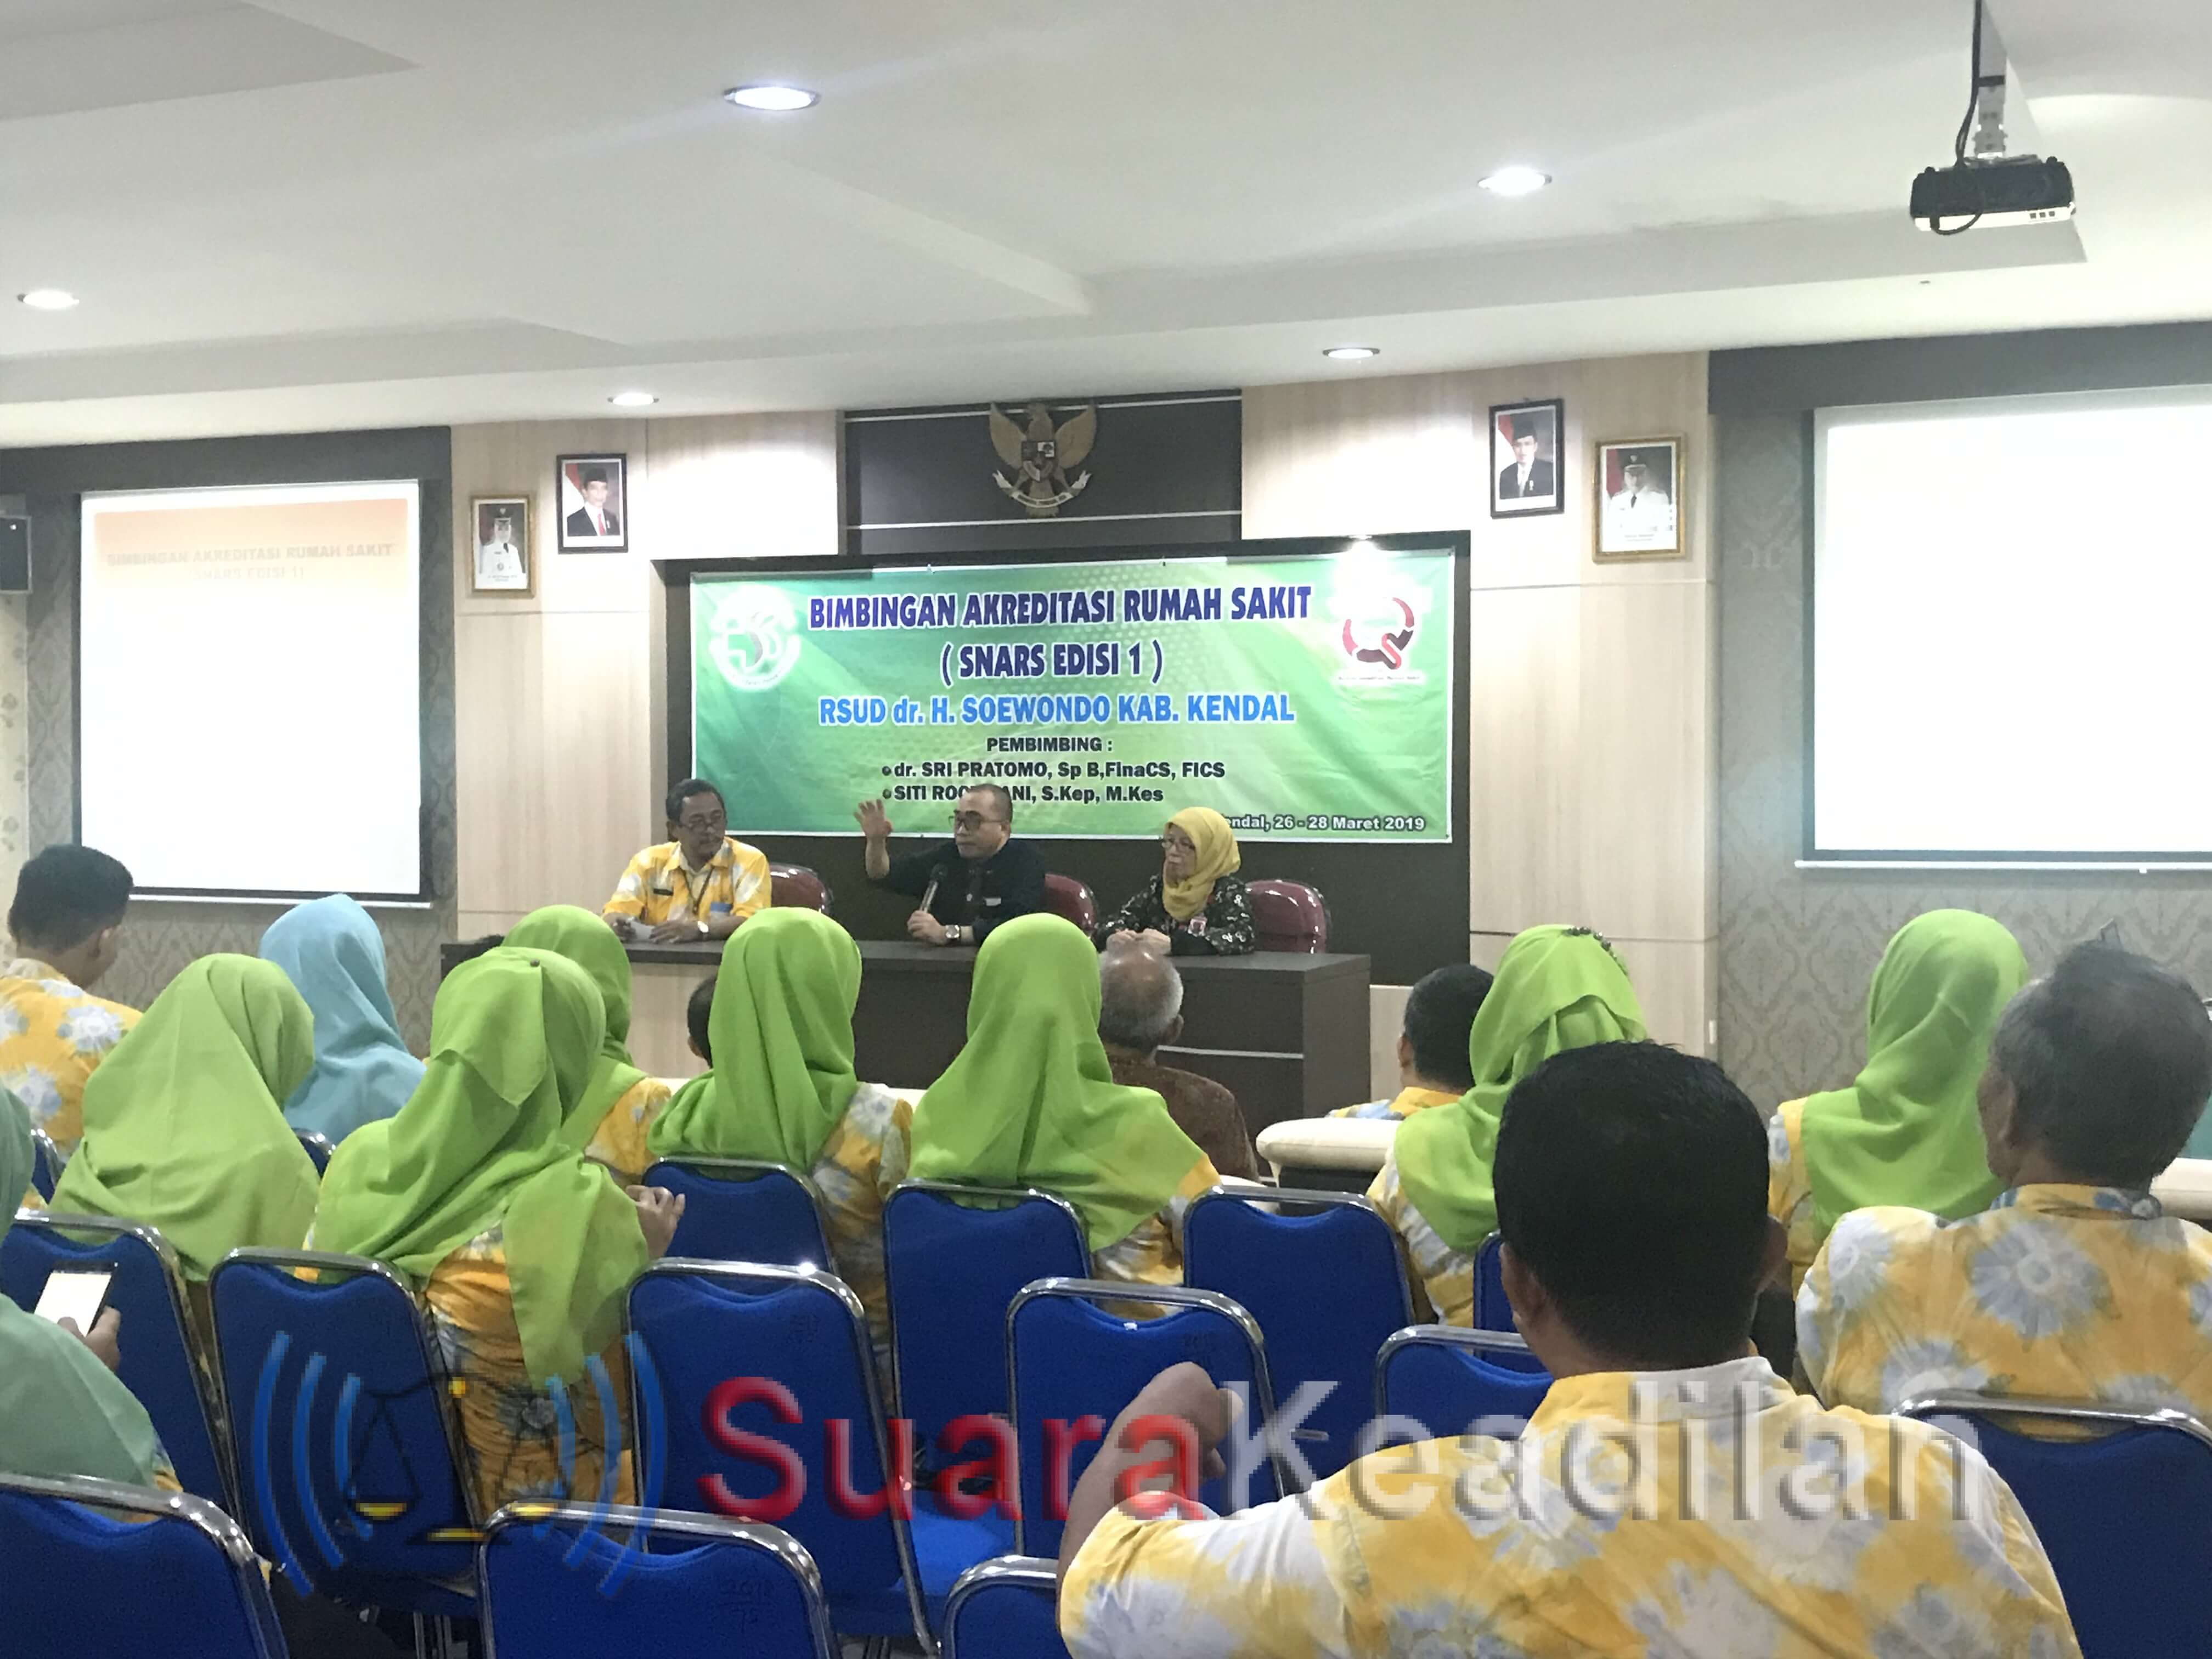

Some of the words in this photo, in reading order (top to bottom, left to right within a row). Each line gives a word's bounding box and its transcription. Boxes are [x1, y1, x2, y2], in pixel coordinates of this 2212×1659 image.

[193, 546, 281, 562] AKREDITASI
[285, 544, 342, 559] RUMAH
[346, 542, 393, 557] SAKIT
[810, 595, 956, 629] BIMBINGAN
[963, 590, 1115, 625] AKREDITASI
[1124, 588, 1222, 622] RUMAH
[1231, 585, 1311, 620] SAKIT
[959, 644, 1045, 678] SNARS
[1054, 642, 1119, 676] EDISI
[1128, 641, 1141, 675] 1
[820, 698, 887, 724] RSUD
[893, 698, 924, 724] dr.
[932, 697, 955, 723] H.
[961, 695, 1111, 723] SOEWONDO
[1119, 695, 1180, 722] KAB.
[1187, 694, 1295, 721] KENDAL
[987, 737, 1103, 752] PEMBIMBING
[894, 762, 917, 777] dr.
[921, 761, 952, 777] SRI
[958, 761, 1053, 780] PRATOMO,
[1057, 761, 1082, 780] Sp
[1182, 762, 1226, 777] FICS
[894, 785, 927, 800] SITI
[1041, 785, 1100, 804] S.Kep,
[1106, 786, 1164, 802] M.Kes
[1273, 815, 1294, 830] 26
[1307, 815, 1328, 830] 28
[1331, 815, 1381, 831] Maret
[1384, 816, 1426, 831] 2019
